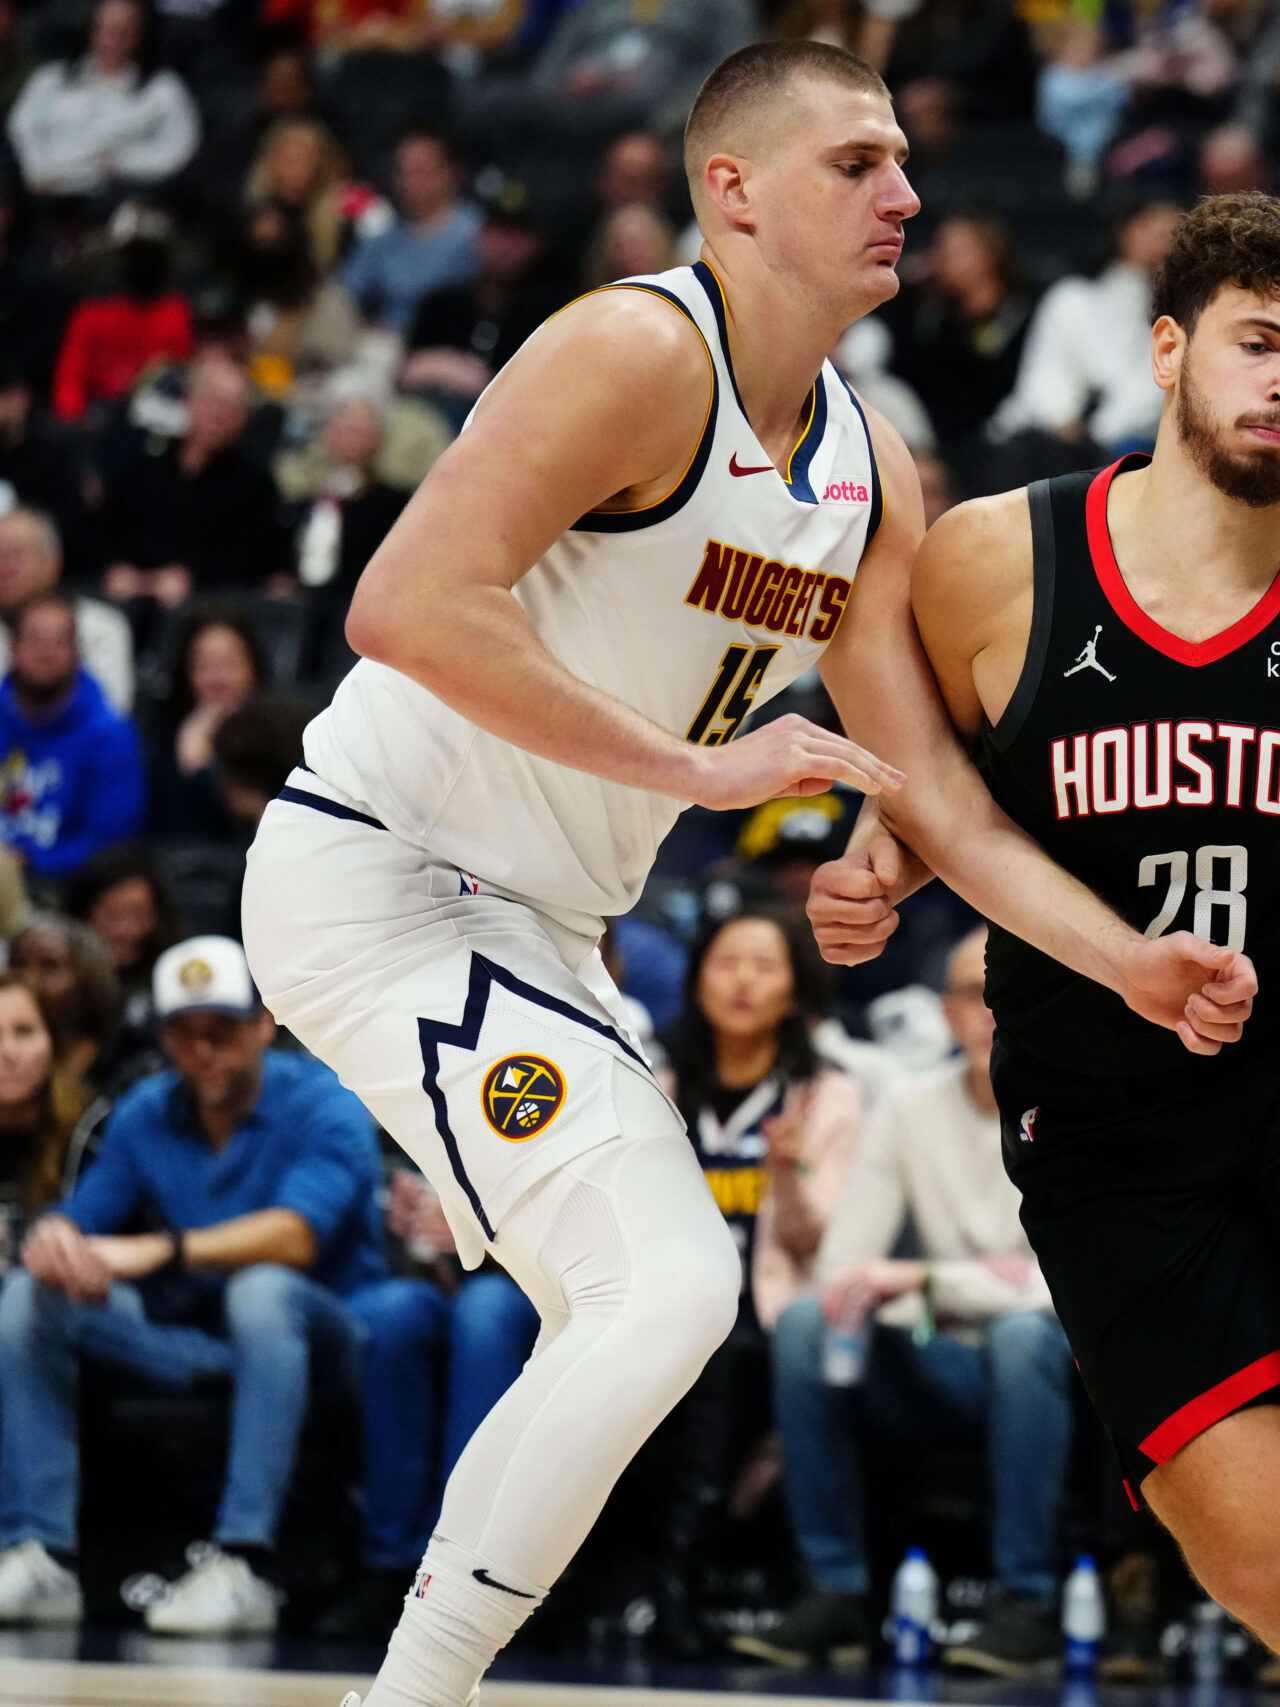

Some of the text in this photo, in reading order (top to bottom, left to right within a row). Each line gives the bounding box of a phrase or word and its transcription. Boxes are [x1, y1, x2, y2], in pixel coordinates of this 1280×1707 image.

[684, 538, 853, 643] NUGGETS
[685, 643, 783, 746] 15
[1138, 845, 1248, 953] 28
